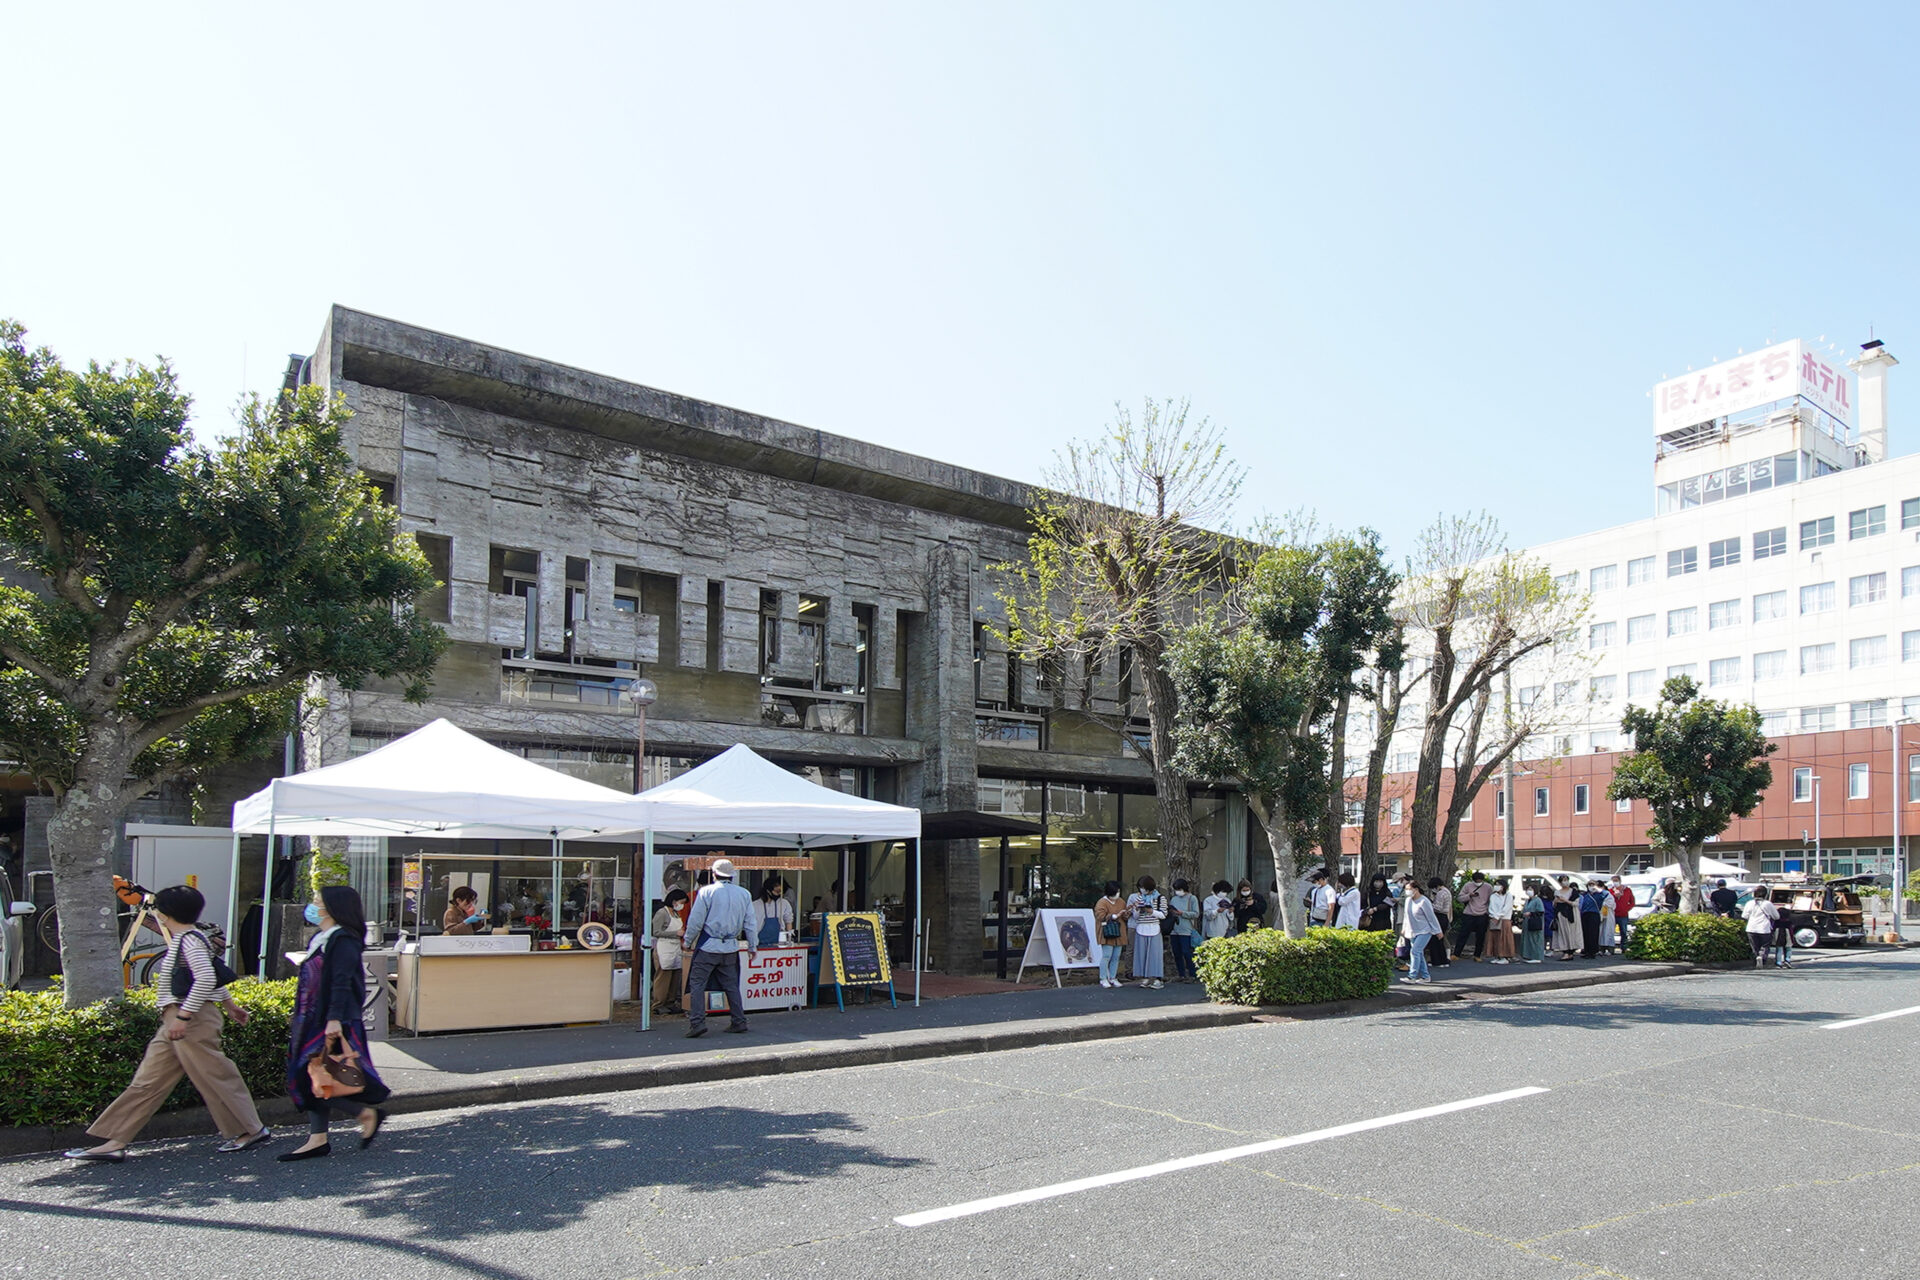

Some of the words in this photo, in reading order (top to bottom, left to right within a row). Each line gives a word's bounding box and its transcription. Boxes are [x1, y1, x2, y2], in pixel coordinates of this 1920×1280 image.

[1661, 350, 1791, 415] ほんまち
[1801, 351, 1850, 409] ホテル
[1672, 388, 1770, 426] ビジネスホテル
[1681, 458, 1771, 497] ほんまち
[746, 986, 805, 999] DANCURRY
[747, 970, 784, 985] கறி
